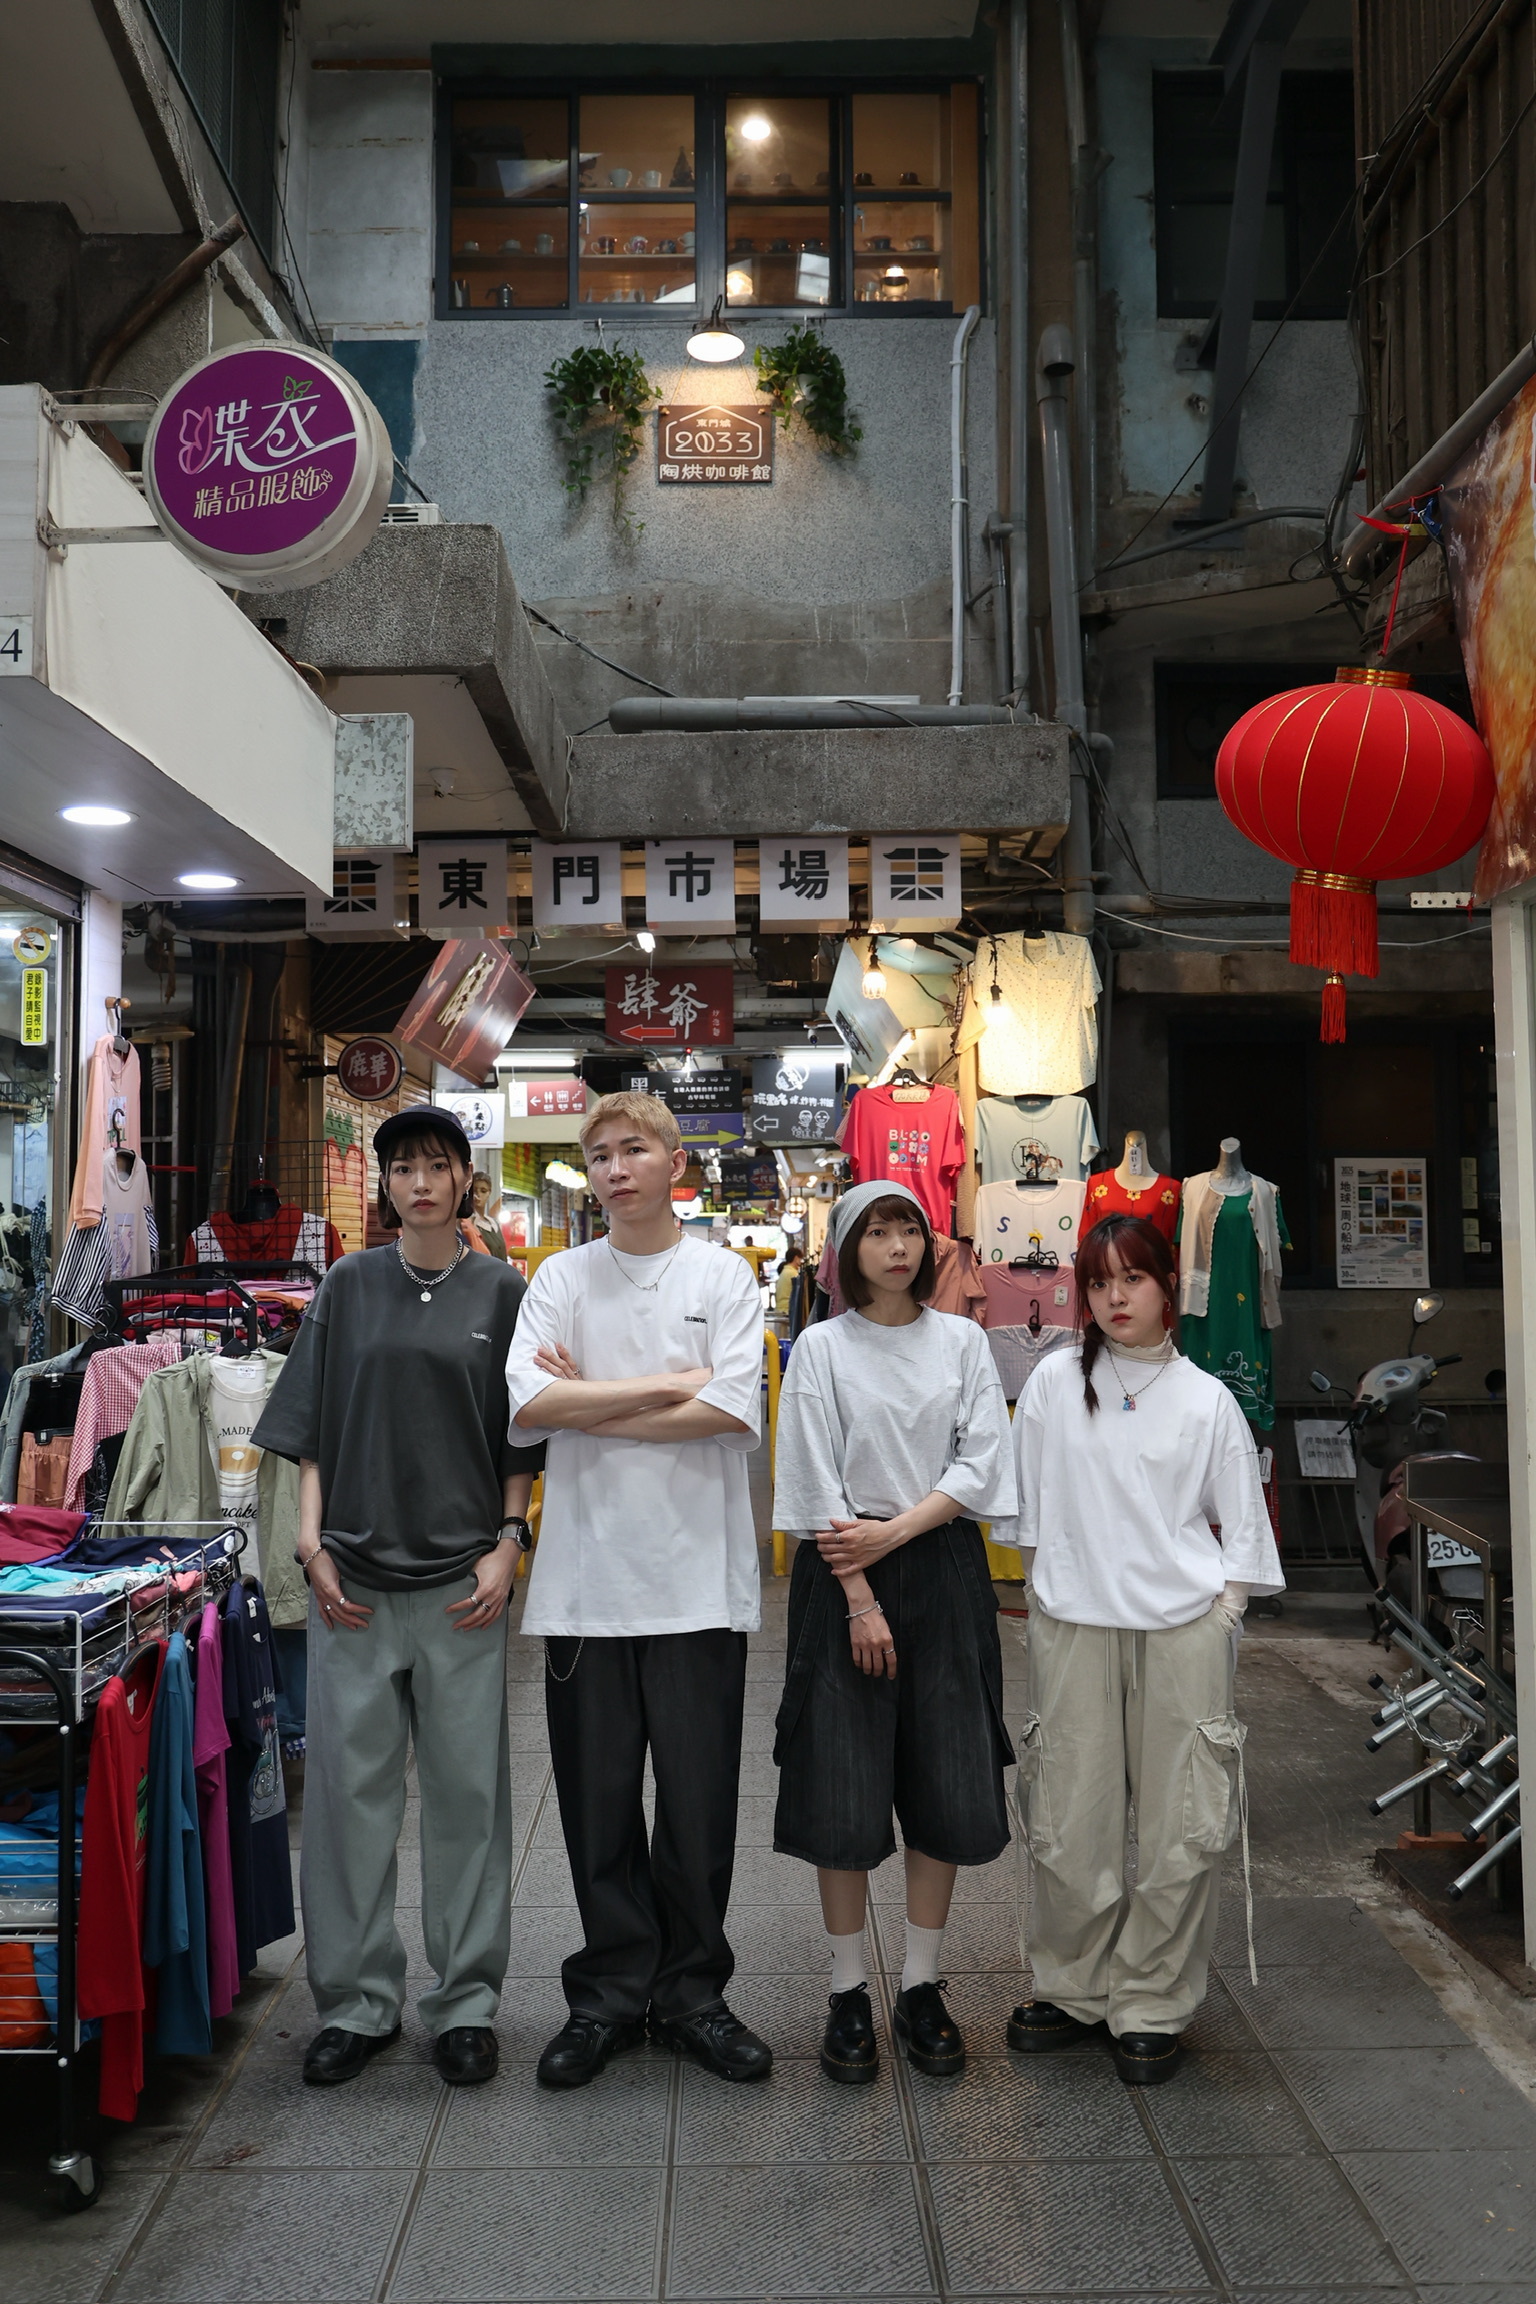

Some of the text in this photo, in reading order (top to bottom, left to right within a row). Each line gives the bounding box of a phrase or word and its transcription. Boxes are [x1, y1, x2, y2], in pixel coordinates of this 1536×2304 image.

[675, 431, 753, 453] 2033
[193, 467, 329, 520] 精品服飾
[659, 463, 772, 480] 陶烘咖啡館
[0, 628, 23, 663] 4
[438, 849, 831, 909] 東門市場
[617, 968, 709, 1040] 肆爺
[1340, 1180, 1353, 1255] 地球一周の船旅
